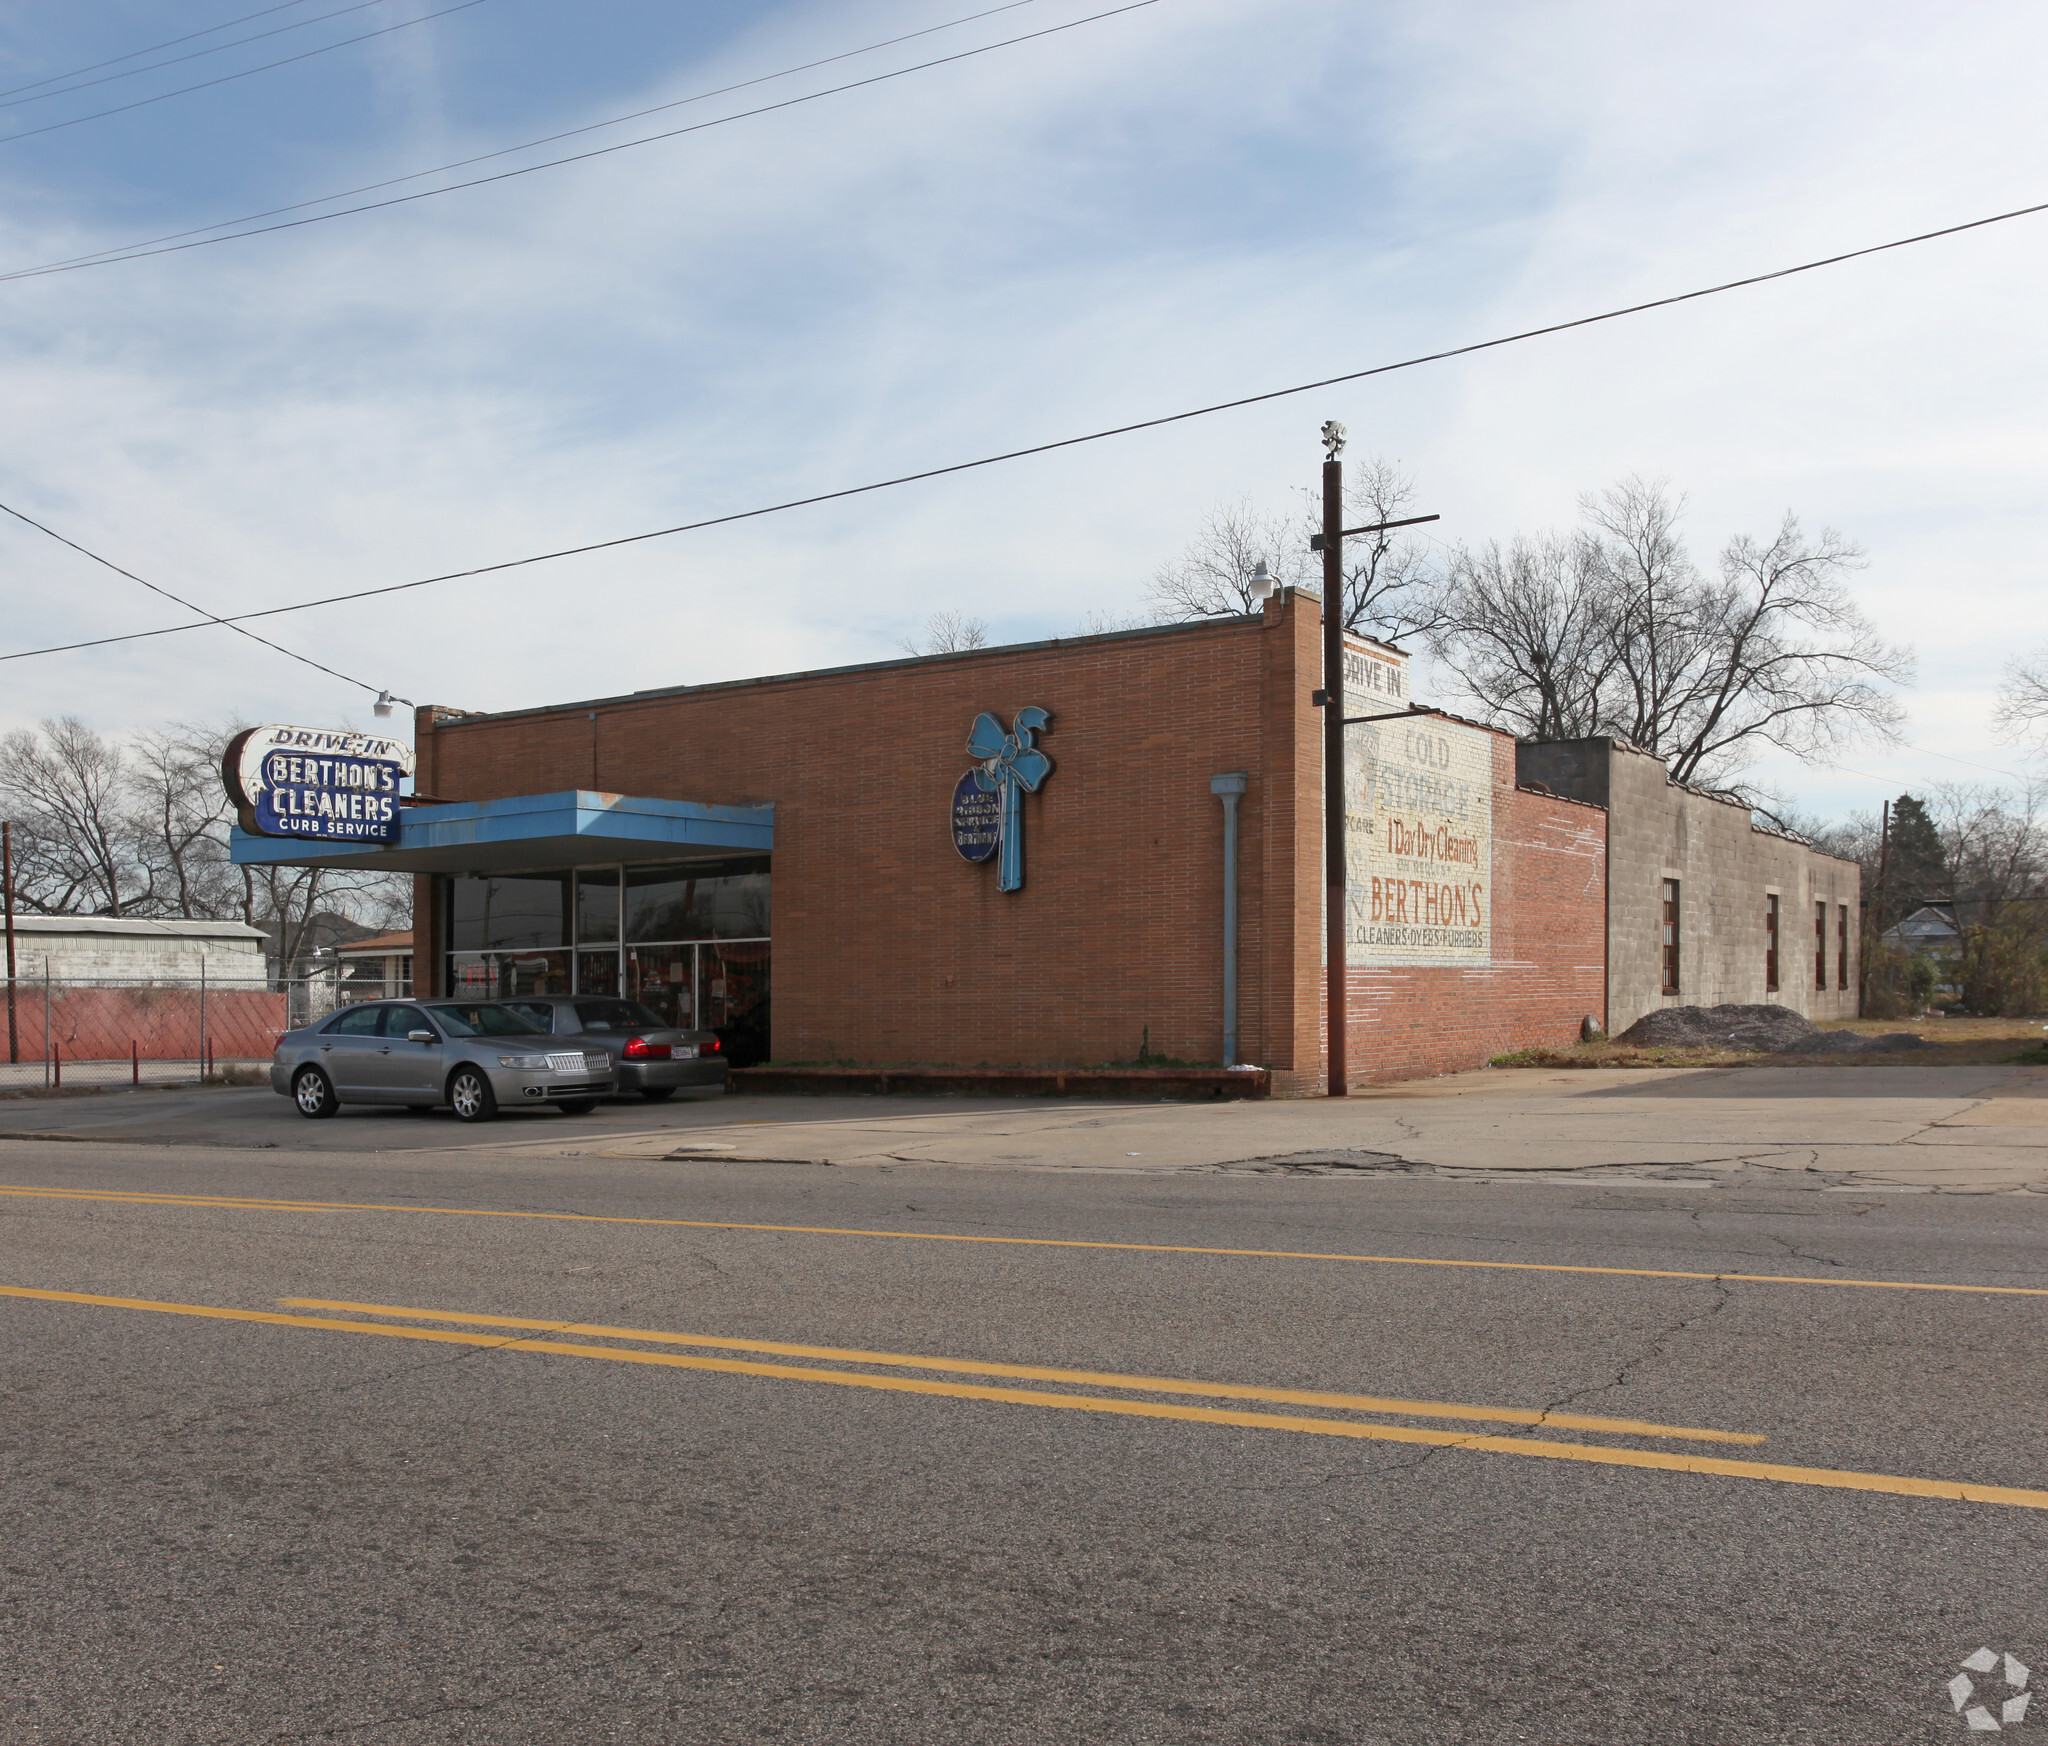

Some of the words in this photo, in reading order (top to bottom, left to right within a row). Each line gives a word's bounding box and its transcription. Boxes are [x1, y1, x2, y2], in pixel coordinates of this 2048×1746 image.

[1387, 666, 1401, 697] IN
[275, 729, 392, 755] DRIVE-IN
[1405, 728, 1449, 770] COLD
[273, 756, 394, 791] BERTHON'S
[273, 788, 393, 822] CLEANERS
[279, 818, 320, 832] CURB
[327, 820, 387, 837] SERVICE
[1395, 818, 1416, 856] Day
[1417, 822, 1436, 864] Dry
[1437, 826, 1478, 870] Cleaning
[1371, 876, 1483, 927] BERTHON'S
[1356, 926, 1407, 946] CLEANERS
[1409, 928, 1440, 947] DYERS
[1443, 930, 1483, 948] FURRIERS
[461, 966, 499, 987] OPEN
